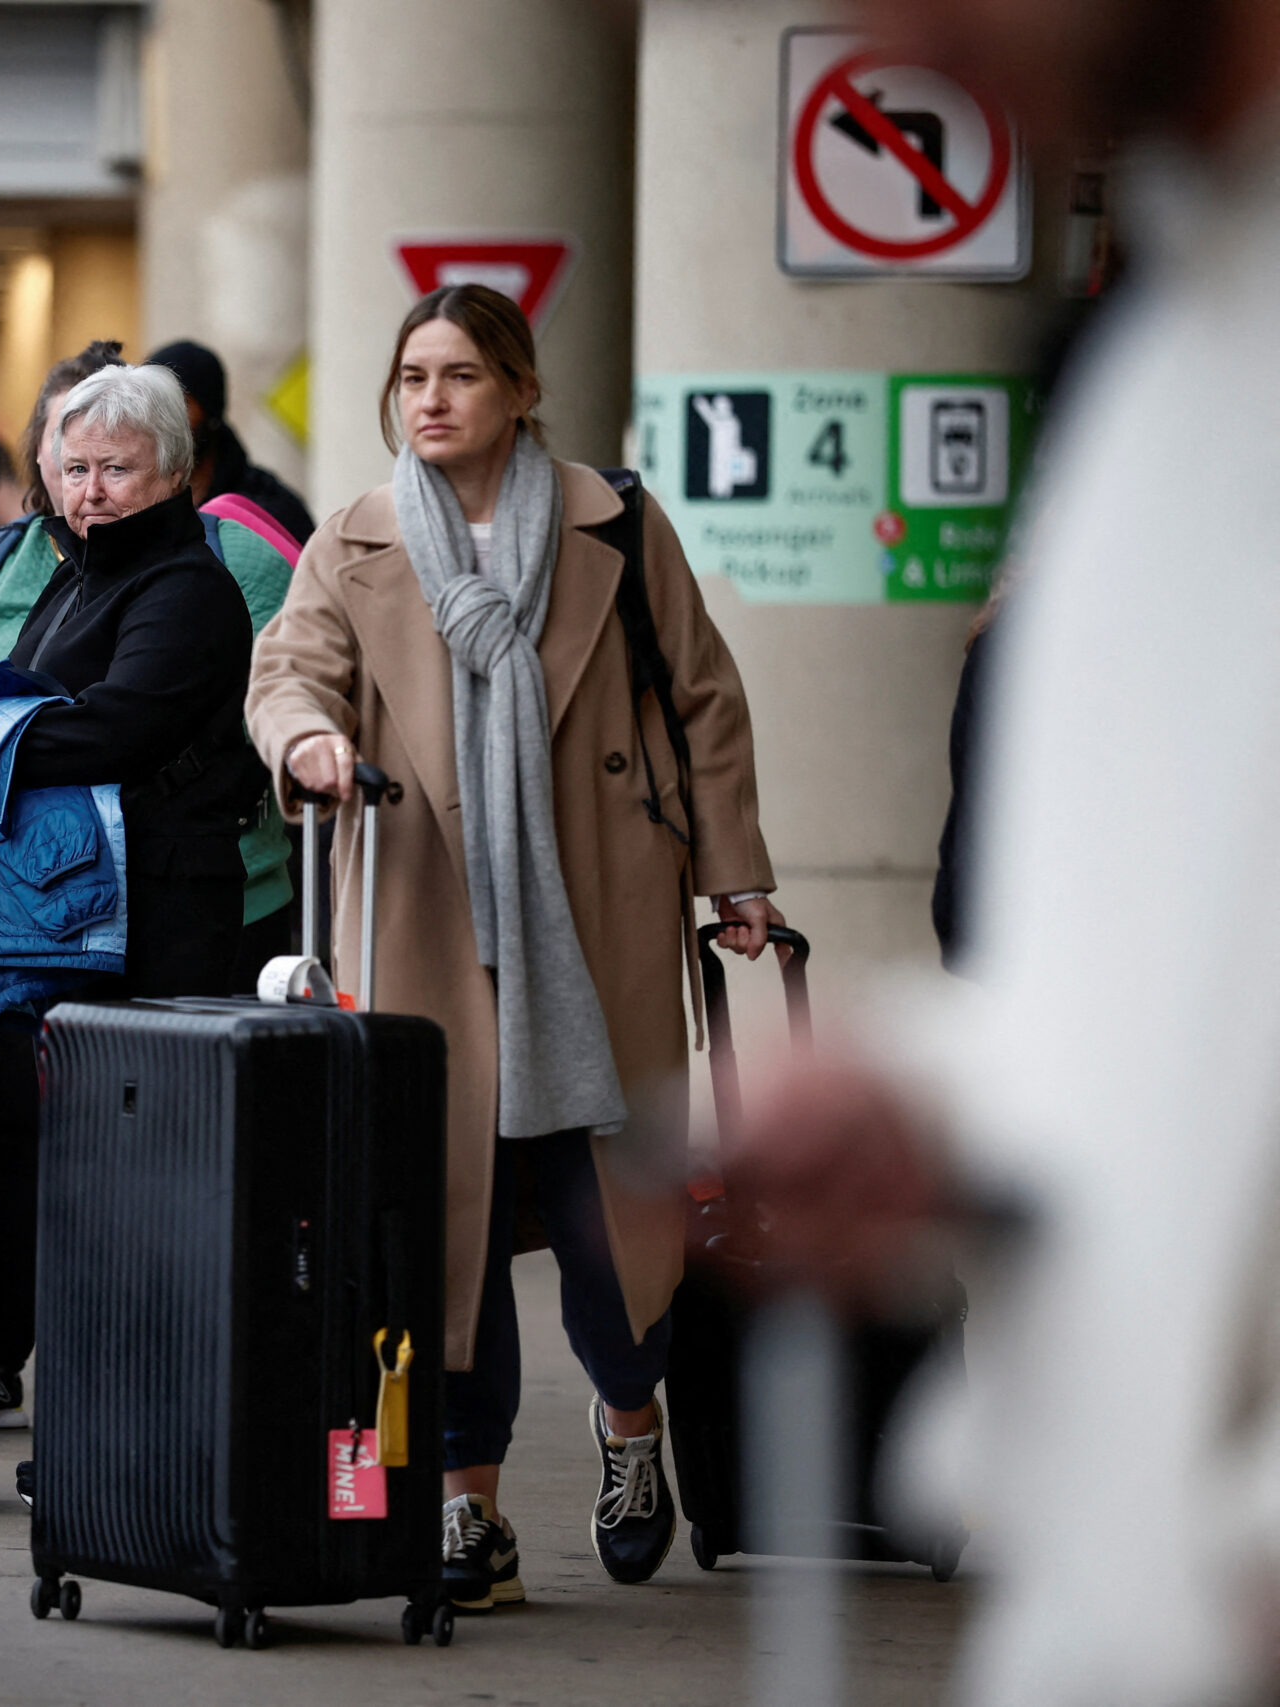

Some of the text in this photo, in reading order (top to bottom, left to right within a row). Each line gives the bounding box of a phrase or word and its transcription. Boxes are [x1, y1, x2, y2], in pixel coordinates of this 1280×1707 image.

[794, 384, 867, 412] Zone
[808, 420, 850, 478] 4
[703, 523, 834, 555] Passenger
[722, 556, 811, 585] Pickup
[334, 1443, 365, 1512] MINE!
